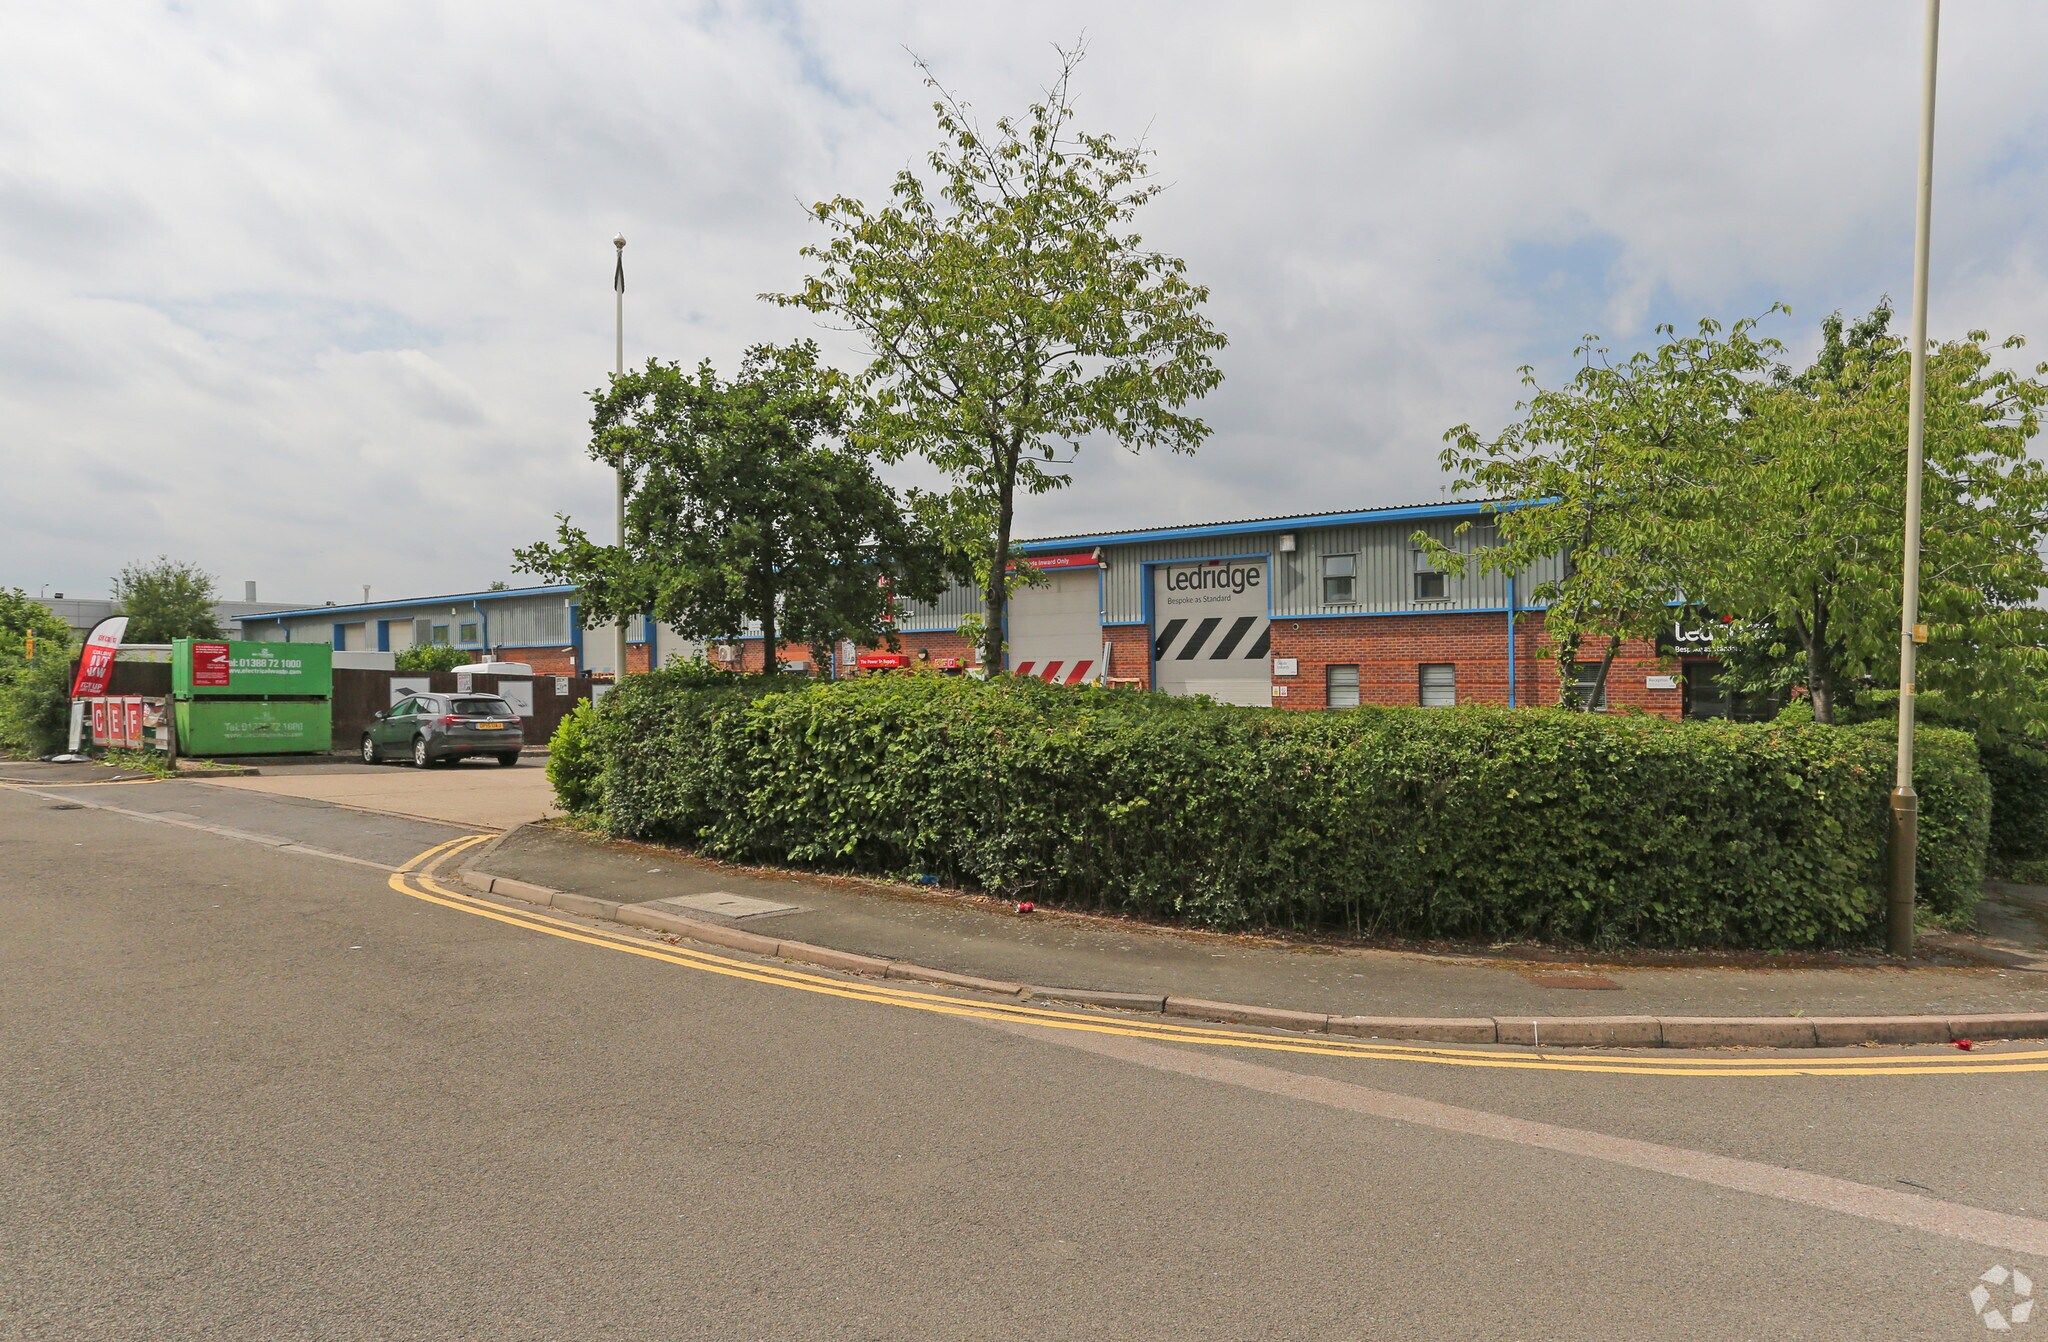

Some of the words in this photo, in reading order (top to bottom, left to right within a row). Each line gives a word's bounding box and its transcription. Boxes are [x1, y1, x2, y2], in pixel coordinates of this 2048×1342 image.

[1167, 596, 1193, 605] Bespoke
[1203, 595, 1231, 603] Standard
[240, 659, 266, 668] 01388
[268, 660, 279, 668] 72
[281, 660, 301, 668] 1000
[92, 682, 103, 690] UP
